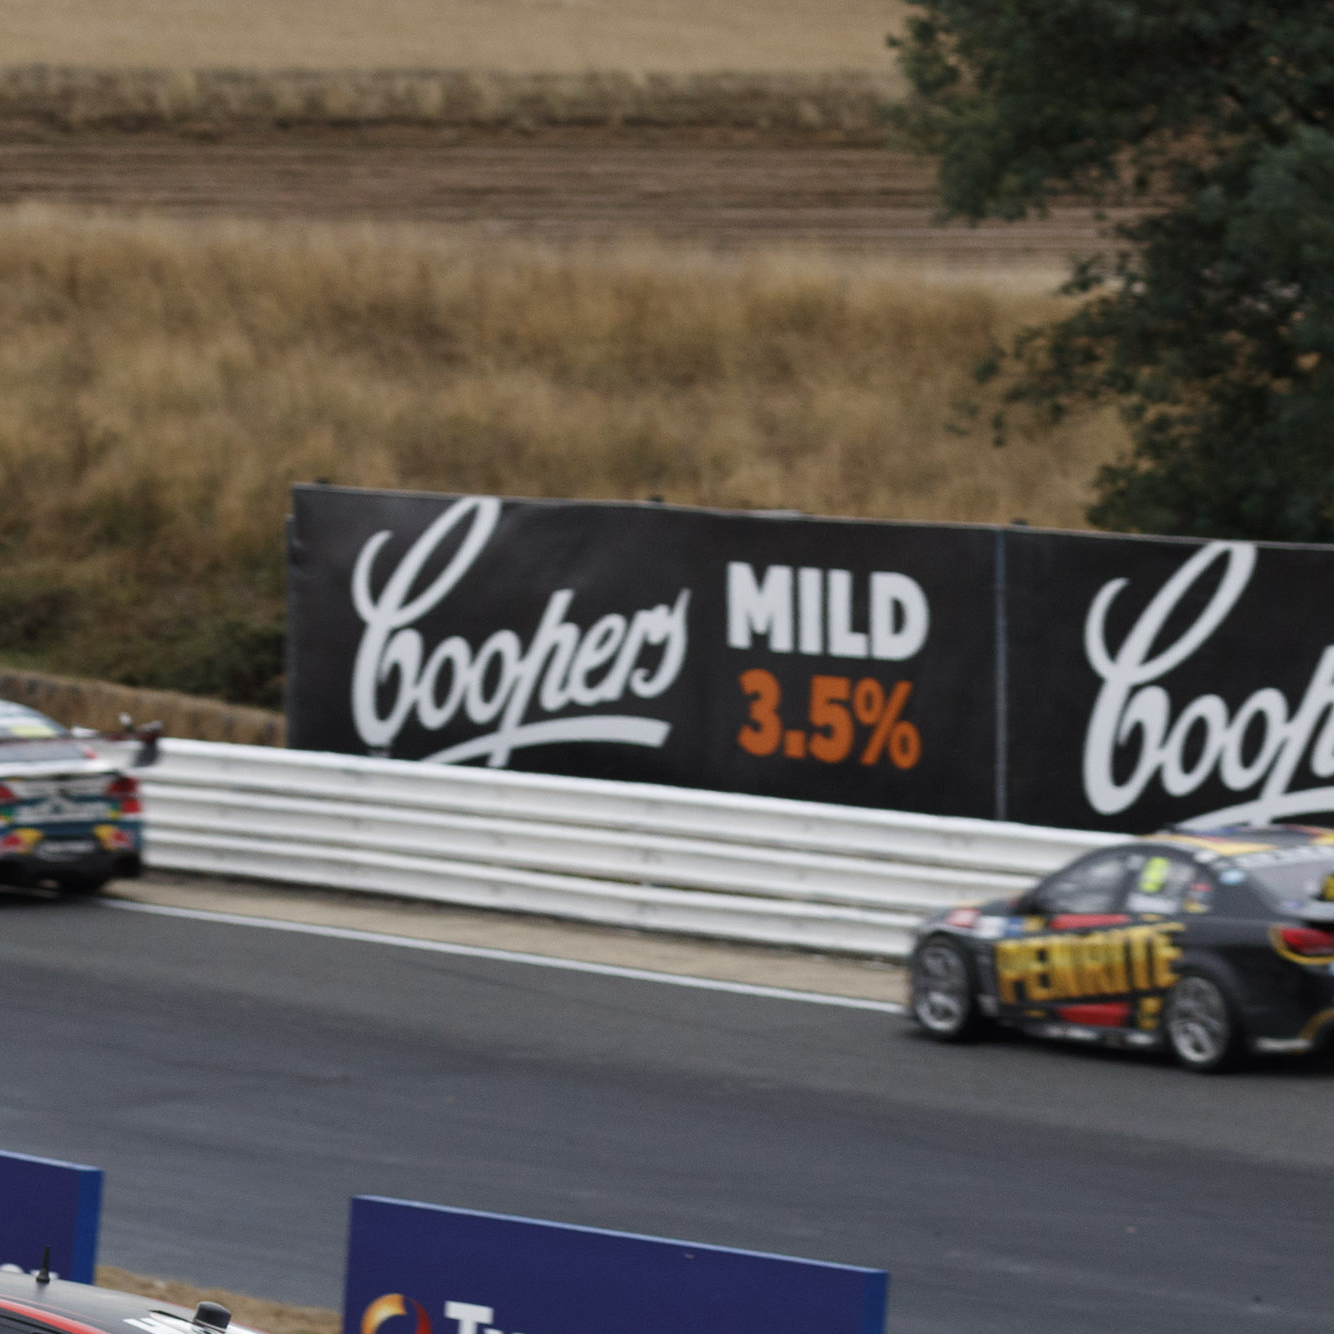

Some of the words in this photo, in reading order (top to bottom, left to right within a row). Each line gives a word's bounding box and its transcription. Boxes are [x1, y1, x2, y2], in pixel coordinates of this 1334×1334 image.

[352, 496, 691, 768] Coopers
[727, 562, 929, 660] MILD
[738, 669, 922, 770] 3.5%
